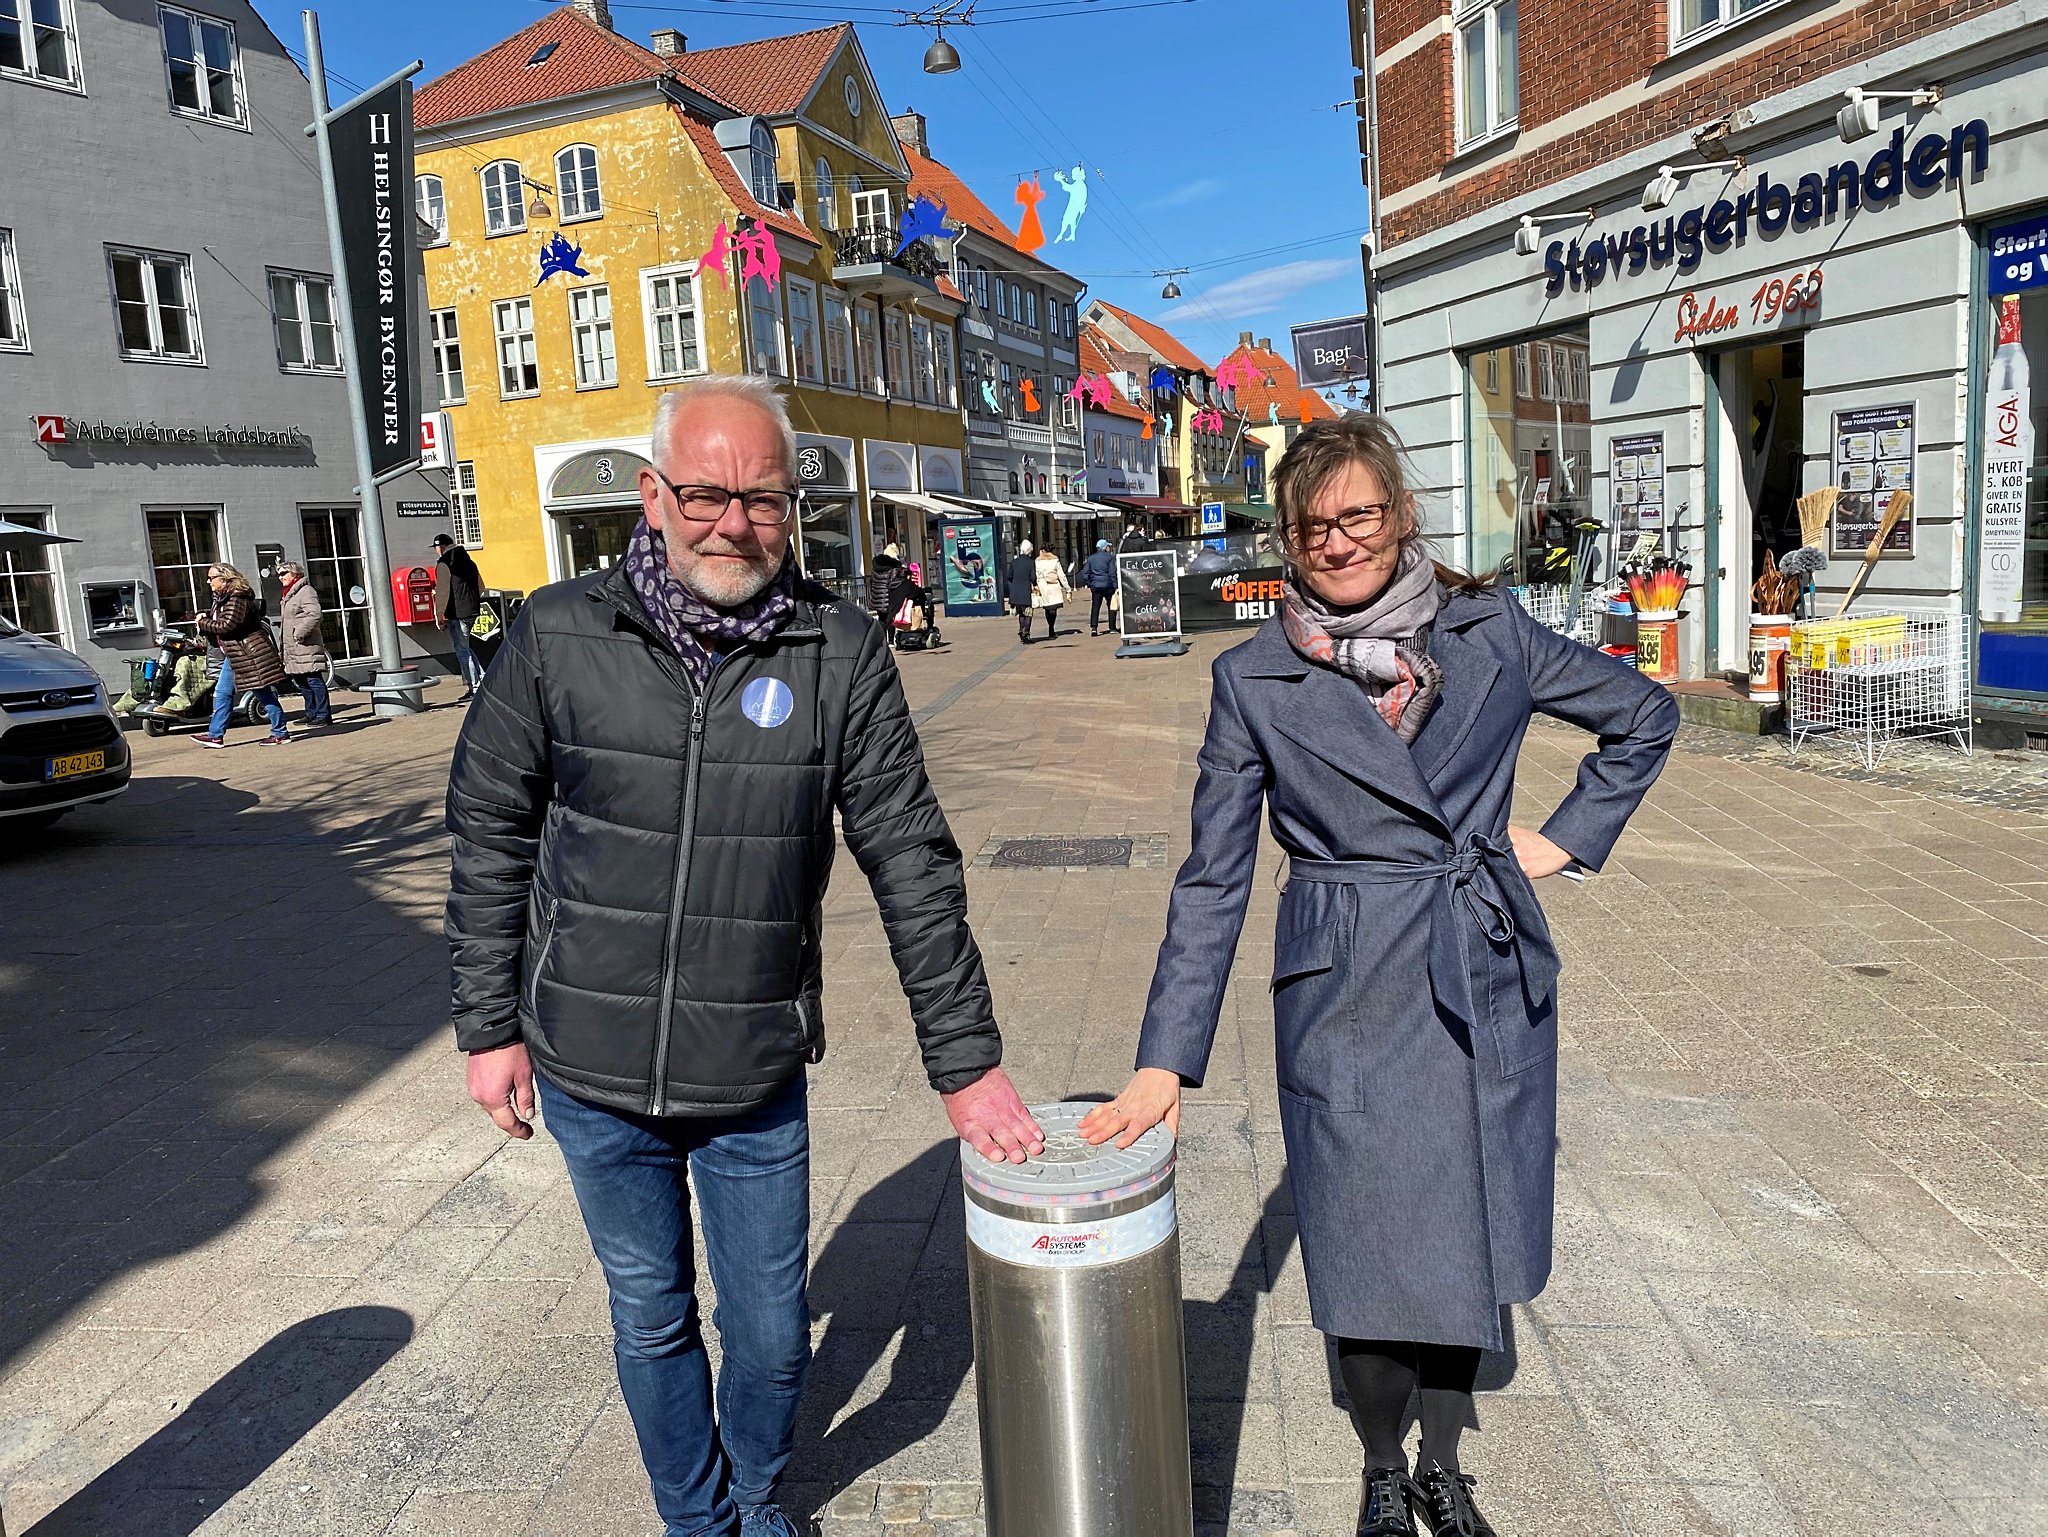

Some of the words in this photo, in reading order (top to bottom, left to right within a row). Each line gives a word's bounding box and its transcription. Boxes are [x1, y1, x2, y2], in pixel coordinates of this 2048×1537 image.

[368, 113, 391, 144] H
[1545, 118, 1990, 293] Støvsugerbanden
[373, 151, 394, 305] HELSINGØR
[1993, 229, 2048, 257] Stort
[2006, 262, 2033, 281] og
[1675, 291, 1738, 340] Siden
[1751, 269, 1824, 323] 1962
[1313, 344, 1352, 366] Bagt
[380, 315, 399, 446] BYCENTER
[1853, 414, 1912, 425] FORÅRSRENGØRINGEN
[1996, 398, 2018, 447] AGA
[76, 420, 198, 446] Arbejdernes
[204, 424, 300, 445] Landsbank
[423, 451, 439, 463] ank
[799, 448, 823, 480] 3
[596, 459, 614, 485] 3
[1987, 461, 2023, 474] HVERT
[1987, 477, 1996, 487] 5.
[2002, 476, 2022, 487] KØB
[1986, 491, 2008, 500] GIVER
[2013, 491, 2022, 499] EN
[1986, 502, 2021, 514] GRATIS
[1836, 522, 1881, 532] Støvsugerba
[1985, 517, 2021, 526] KULSYRE-
[1126, 561, 1139, 570] Eat
[1141, 559, 1163, 570] Cake
[1210, 573, 1240, 590] MISS
[1221, 580, 1285, 602] COFFE
[1135, 605, 1158, 615] Coffe
[1235, 601, 1276, 620] DELI
[1638, 633, 1659, 641] uster
[53, 760, 67, 776] AB
[70, 758, 82, 772] 42
[86, 753, 103, 770] 143
[1049, 1232, 1101, 1243] AUTOMATIC
[1049, 1241, 1086, 1250] SYSTEMS
